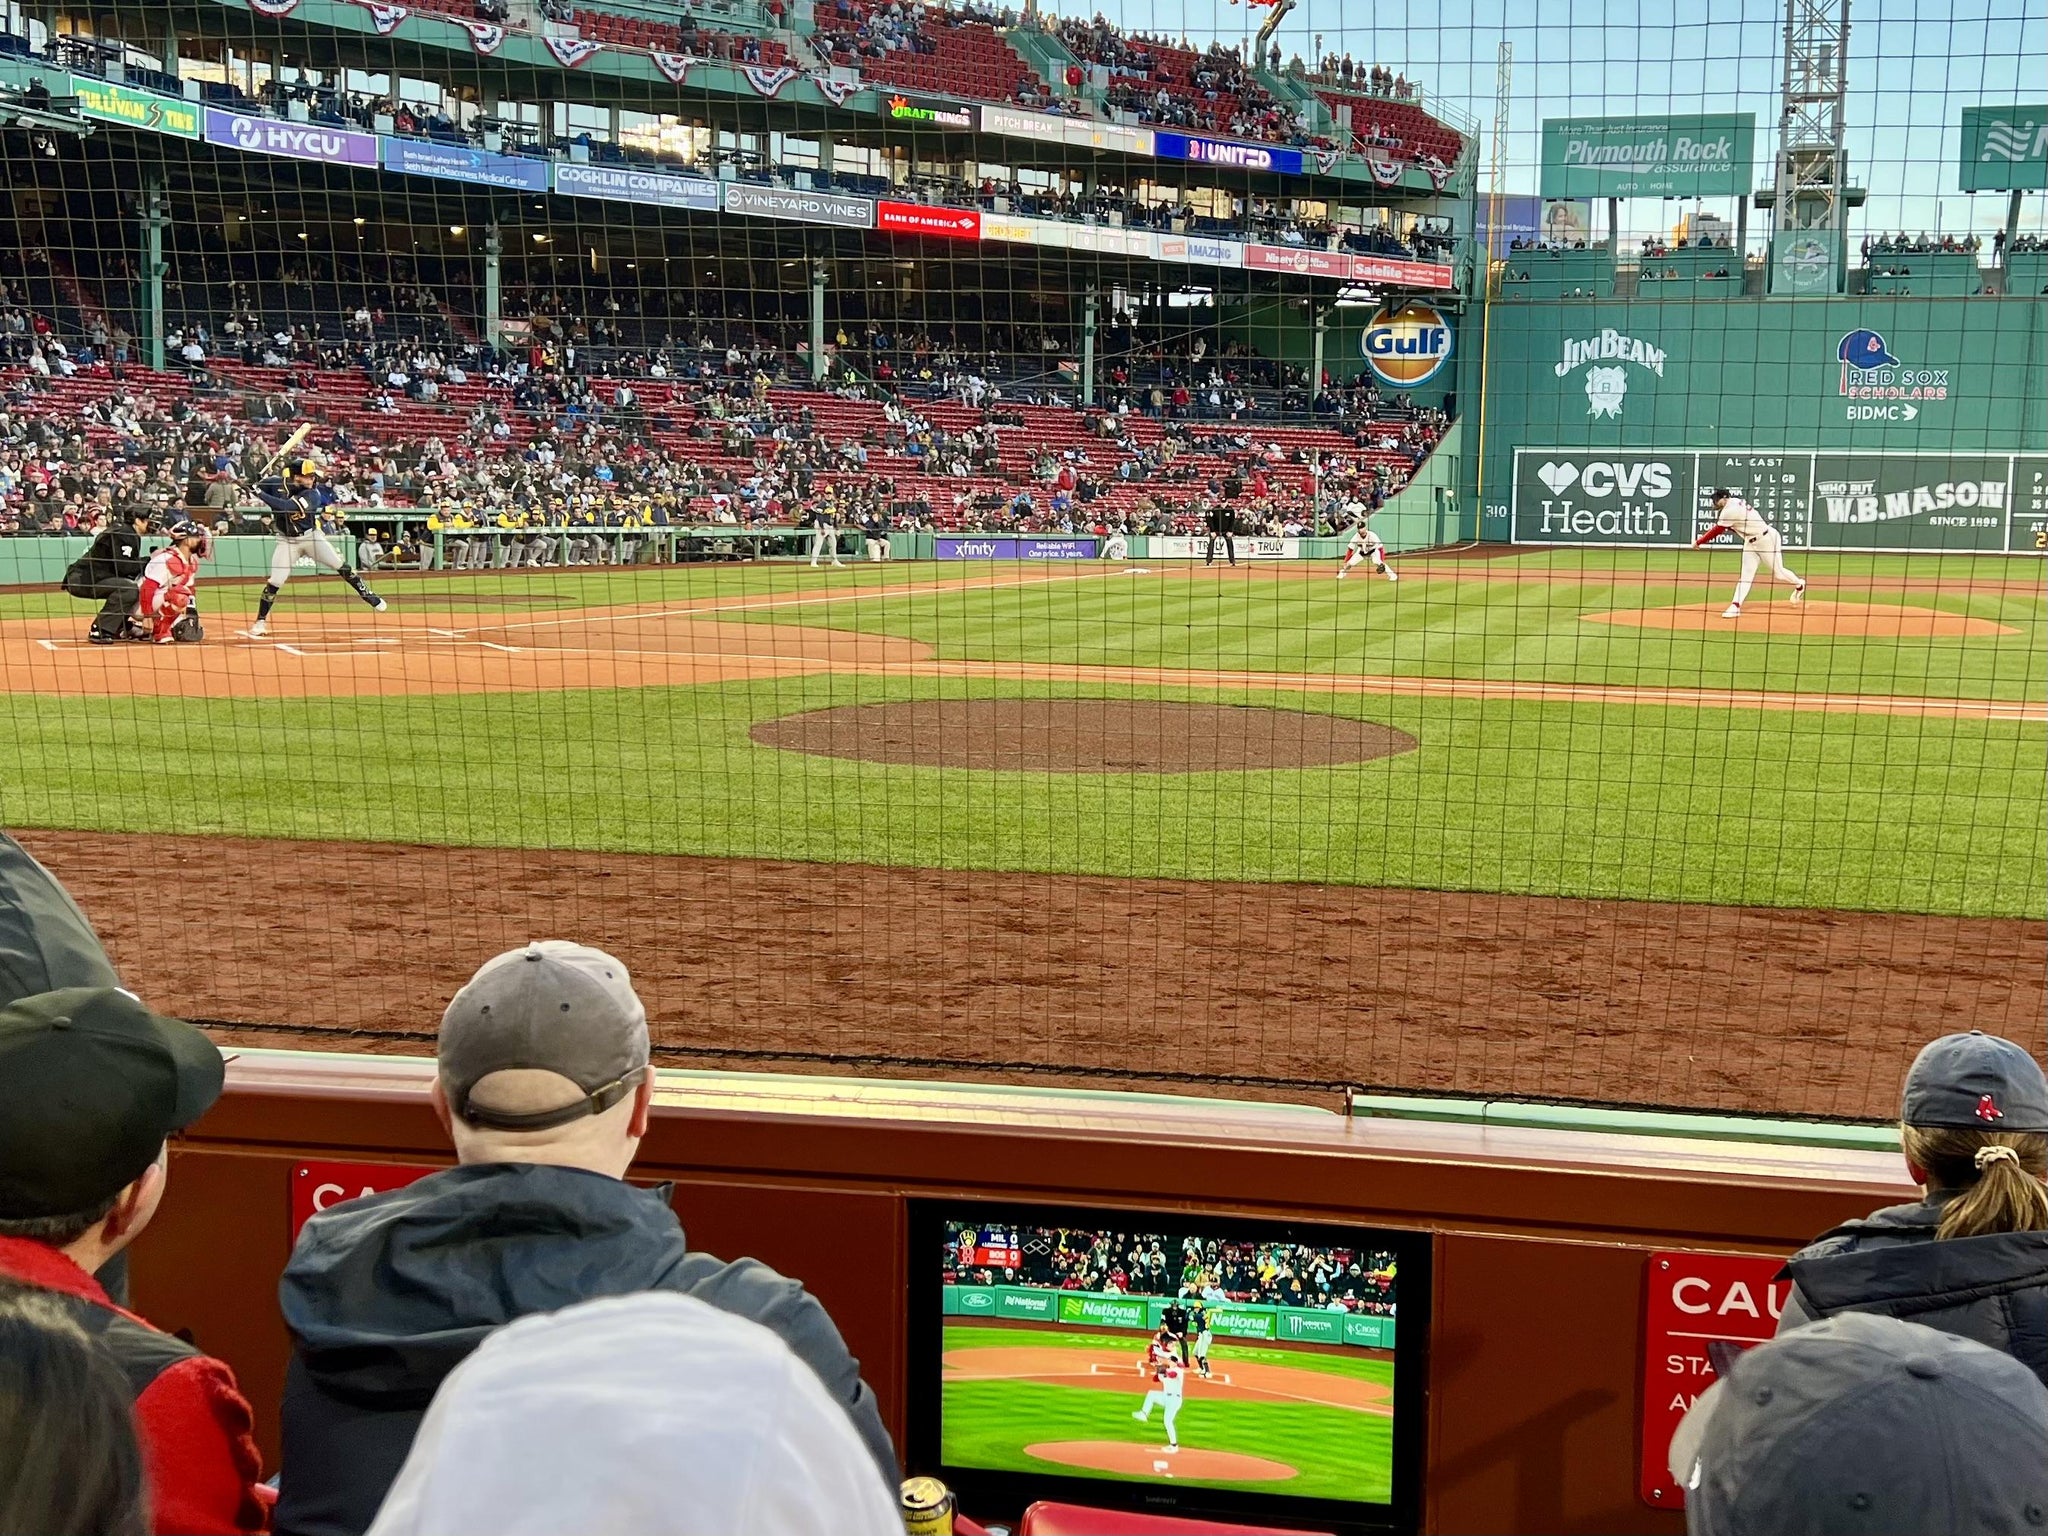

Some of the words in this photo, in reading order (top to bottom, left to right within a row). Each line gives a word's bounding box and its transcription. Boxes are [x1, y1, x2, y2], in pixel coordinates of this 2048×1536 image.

[165, 110, 194, 131] TIRE
[994, 115, 1020, 128] PITCH
[1023, 119, 1053, 133] BREAK
[267, 130, 340, 155] HYCU
[1564, 138, 1668, 164] Plymouth
[1673, 136, 1731, 160] Rock
[558, 168, 626, 187] COGHLIN
[629, 176, 717, 196] COMPANIES
[1650, 182, 1674, 190] HOME
[744, 194, 820, 213] VINEYARD
[822, 203, 867, 219] VINES
[884, 214, 908, 223] BANK
[909, 216, 919, 224] OF
[920, 217, 958, 229] AMERICA
[1188, 244, 1231, 260] AMAZING
[1265, 252, 1293, 266] Ninety
[1366, 328, 1445, 354] Gulf
[1555, 338, 1599, 377] JIM
[1601, 328, 1664, 377] BEAM
[1850, 371, 1895, 385] RED
[1902, 371, 1948, 385] SOX
[1848, 386, 1948, 400] SCHOLARS
[1847, 405, 1899, 420] BIDMC
[1726, 459, 1742, 467] AL
[1749, 459, 1783, 467] EAST
[1581, 461, 1673, 498] CVS
[1754, 474, 1762, 483] W
[1769, 474, 1776, 483] L
[1782, 474, 1795, 483] GB
[1754, 487, 1760, 496] 7
[1769, 487, 1775, 496] 2
[1818, 483, 1846, 496] WHO
[1850, 483, 1874, 496] BUT
[1753, 499, 1760, 508] 5
[1769, 499, 1775, 508] 5
[1784, 500, 1791, 509] 2
[1485, 505, 1507, 518] 310
[1540, 500, 1671, 535] Health
[1768, 511, 1774, 520] 6
[1784, 512, 1790, 520] 3
[1783, 524, 1789, 532] 3
[1929, 516, 1967, 527] SINCE
[1970, 517, 1998, 528] 1898
[1197, 541, 1225, 550] TRLY
[1258, 541, 1284, 551] TRULY
[1782, 536, 1789, 544] 5
[2035, 531, 2047, 548] 2
[955, 541, 996, 557] xfinity
[991, 1233, 1006, 1243] MIL
[1010, 1234, 1018, 1244] 0
[989, 1250, 1006, 1259] BOS
[1010, 1251, 1018, 1261] 0
[1014, 1297, 1048, 1308] National
[1082, 1302, 1141, 1319] National
[1210, 1312, 1270, 1331] National
